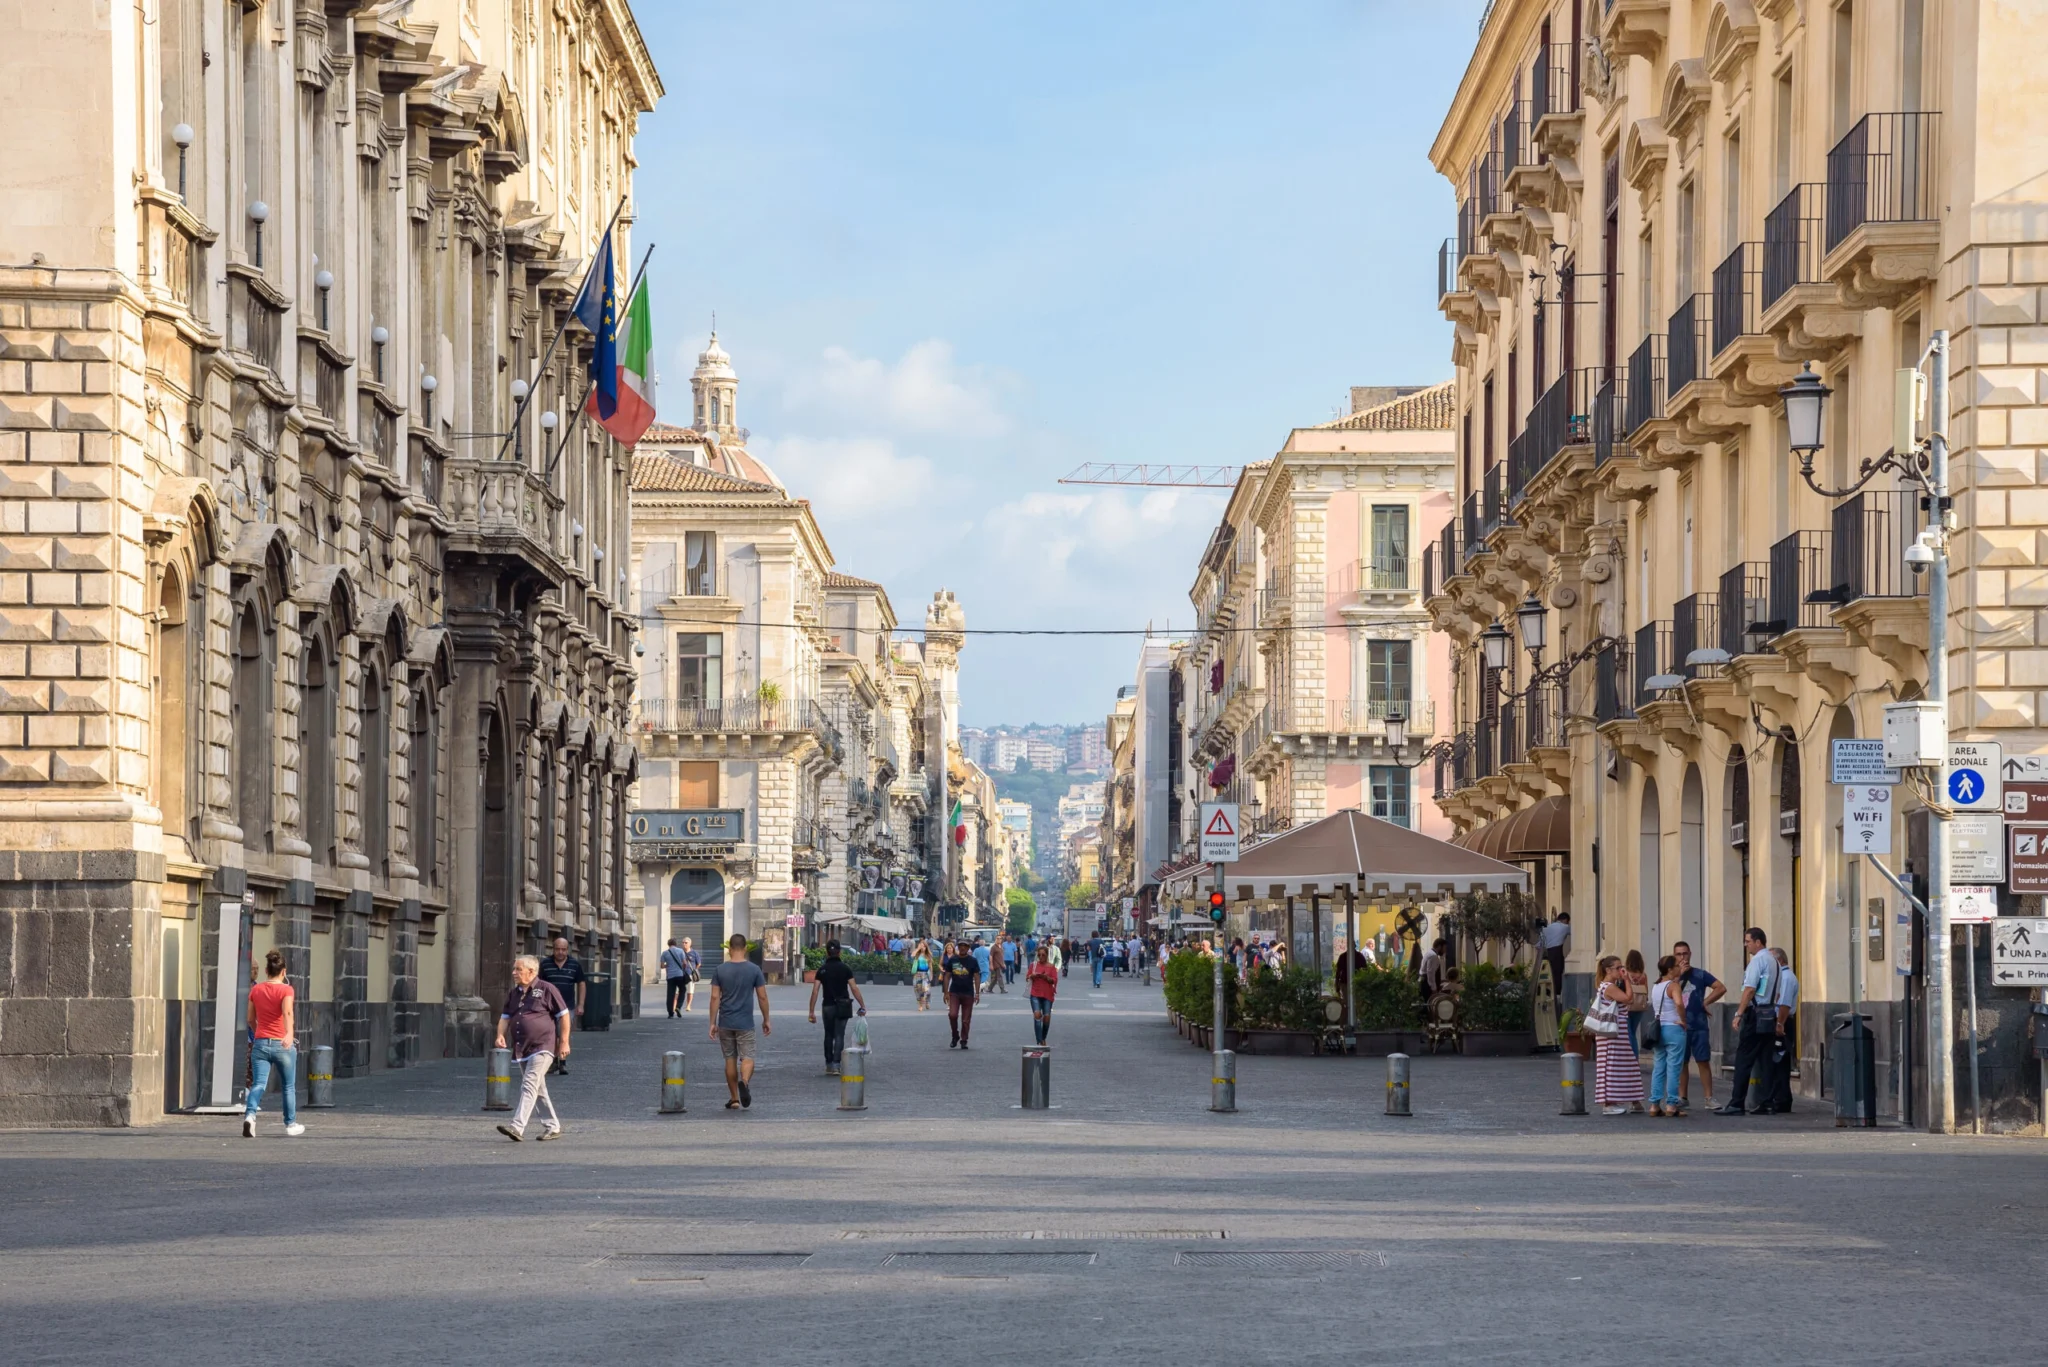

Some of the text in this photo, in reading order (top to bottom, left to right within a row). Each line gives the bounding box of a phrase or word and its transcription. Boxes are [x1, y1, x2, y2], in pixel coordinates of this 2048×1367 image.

[1838, 743, 1884, 751] ATTENZIO
[1954, 747, 1978, 755] AREA
[1948, 758, 1988, 766] EDONALE
[661, 825, 675, 835] DI
[2010, 949, 2048, 958] UNA Pa
